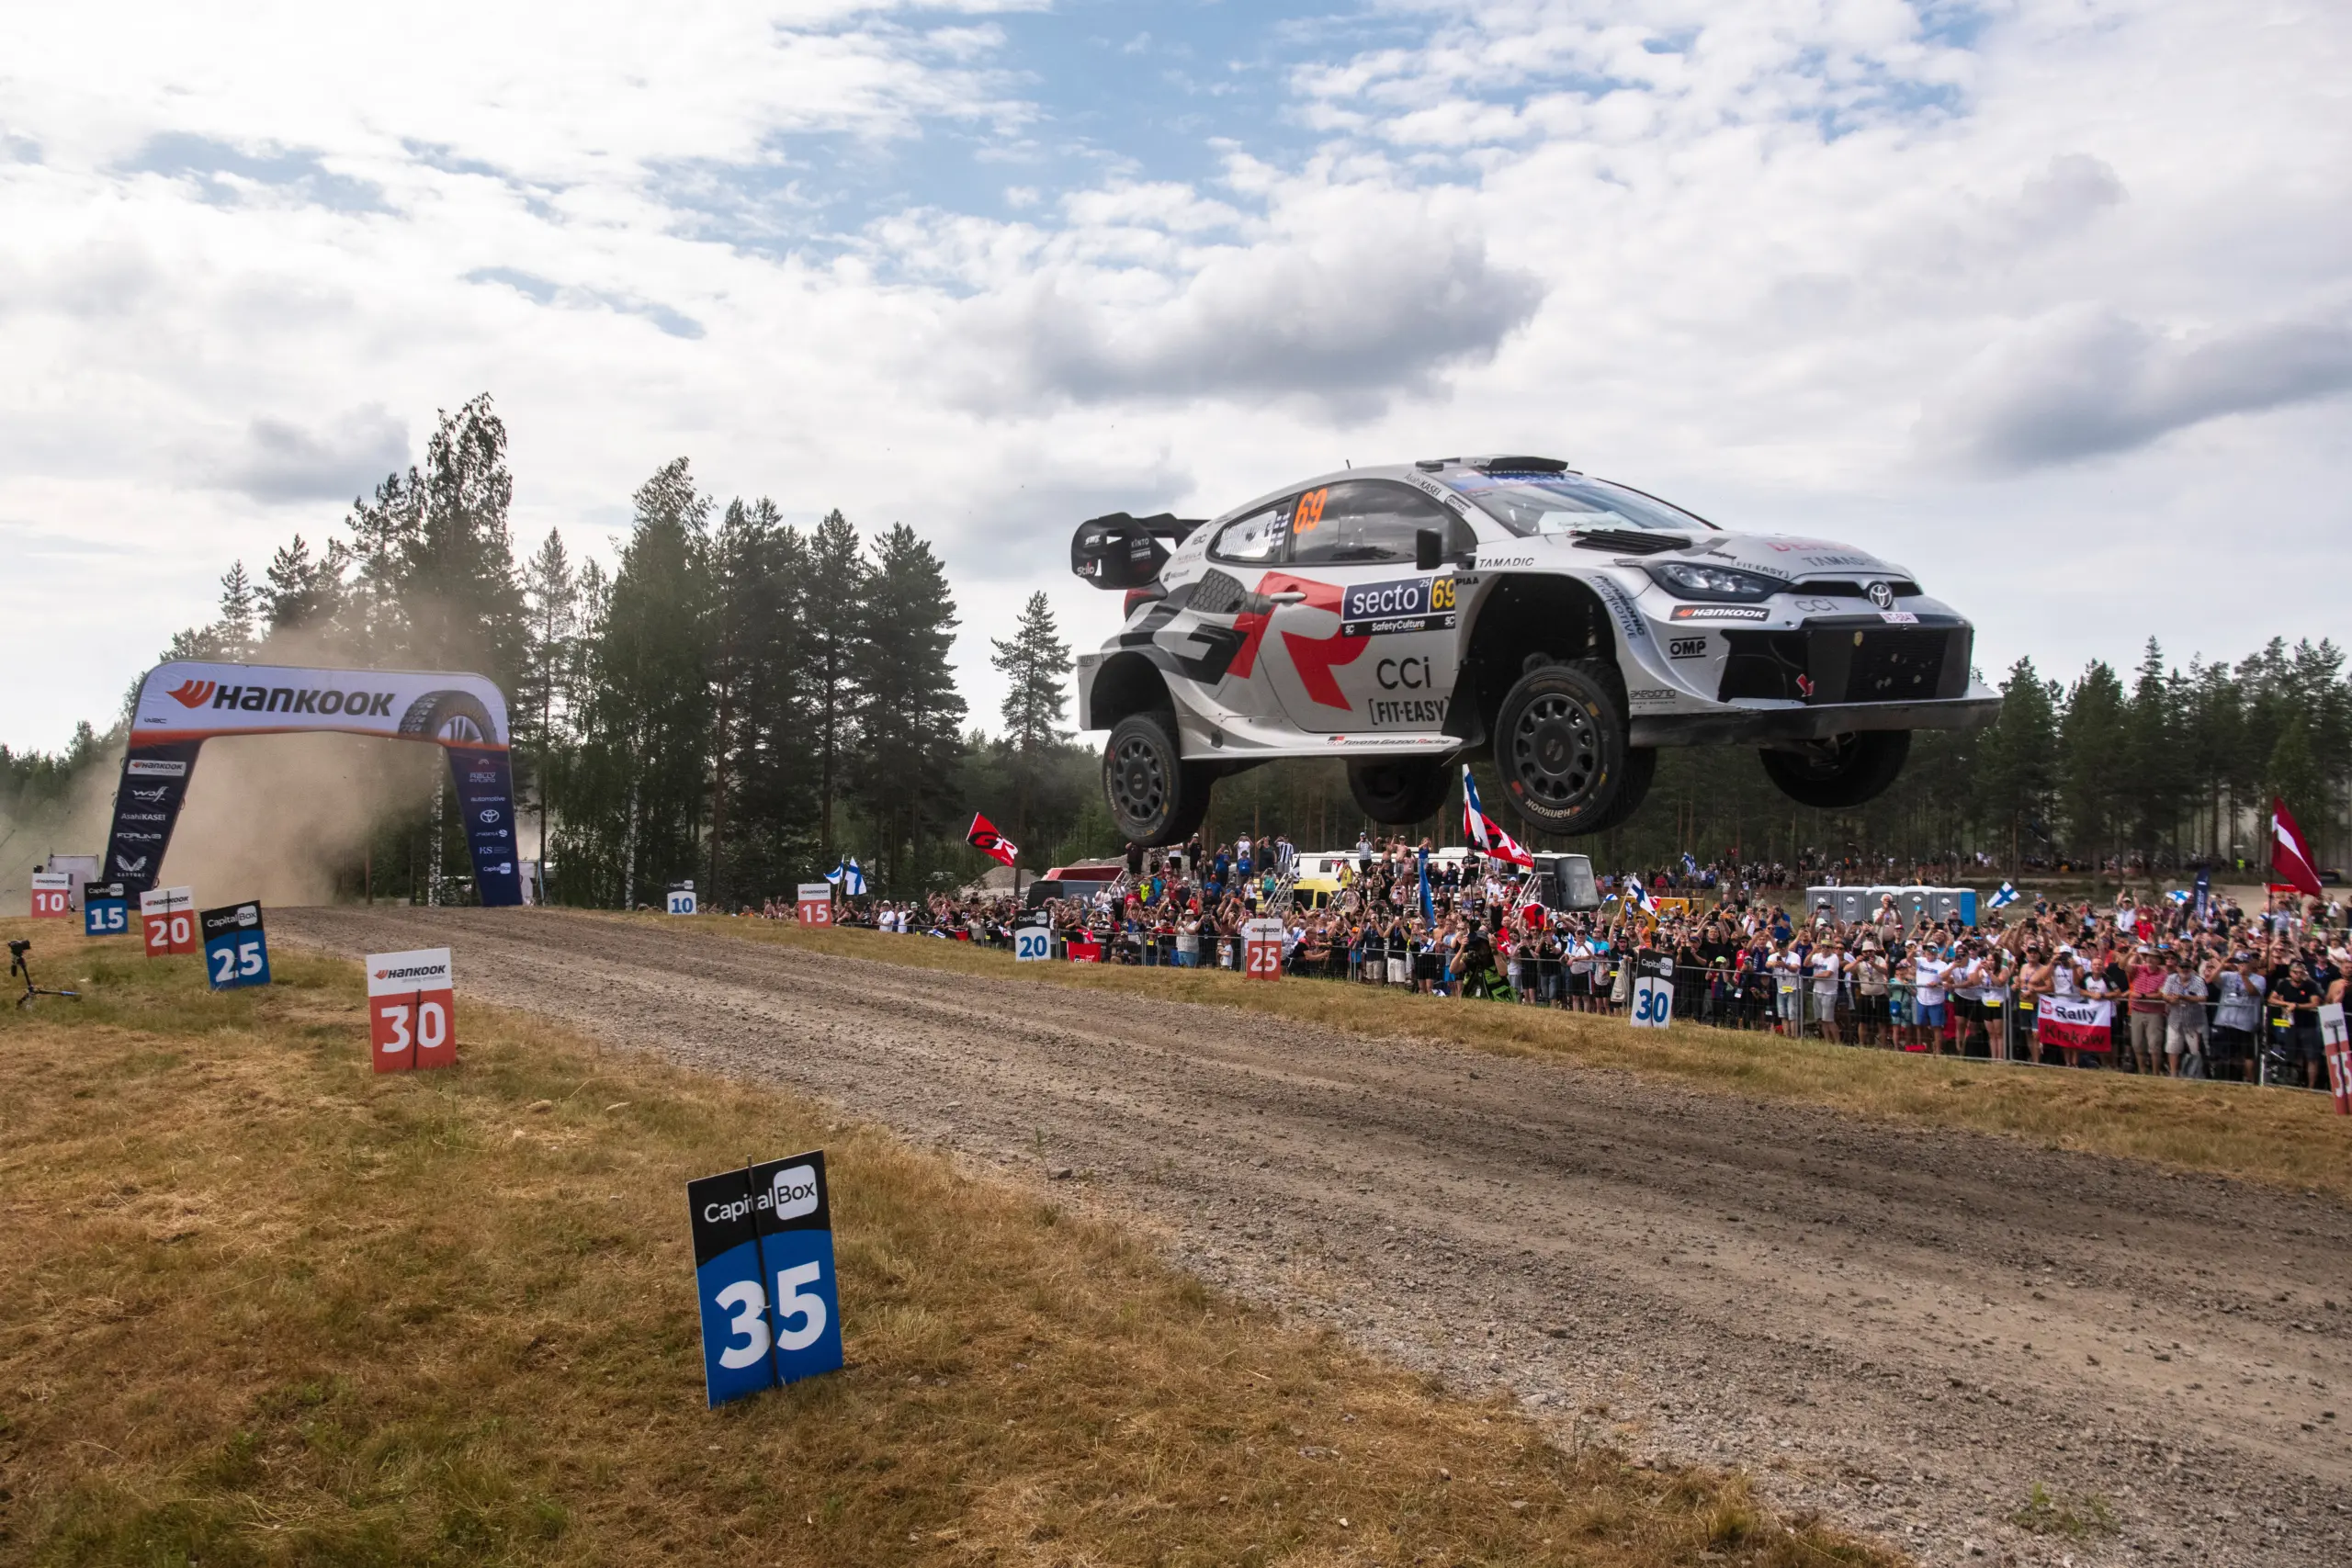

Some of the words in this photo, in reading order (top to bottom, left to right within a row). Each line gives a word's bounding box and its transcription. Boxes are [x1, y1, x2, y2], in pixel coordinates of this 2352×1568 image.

[1294, 488, 1327, 534] 69
[1077, 561, 1094, 576] Stilo
[1479, 558, 1534, 568] TAMADIC
[1456, 577, 1479, 586] PIAA
[1352, 584, 1419, 615] secto
[1432, 579, 1455, 609] 69
[1670, 640, 1706, 655] OMP
[479, 846, 492, 854] KS
[37, 893, 64, 912] 10
[672, 897, 694, 914] 10
[802, 904, 828, 923] 15
[90, 907, 124, 930] 15
[149, 917, 190, 947] 20
[1019, 935, 1047, 957] 20
[212, 942, 264, 983] 25
[1250, 947, 1277, 972] 25
[1635, 988, 1668, 1022] 30
[2055, 1006, 2097, 1024] Rally
[380, 1002, 447, 1054] 30
[715, 1260, 827, 1370] 35
